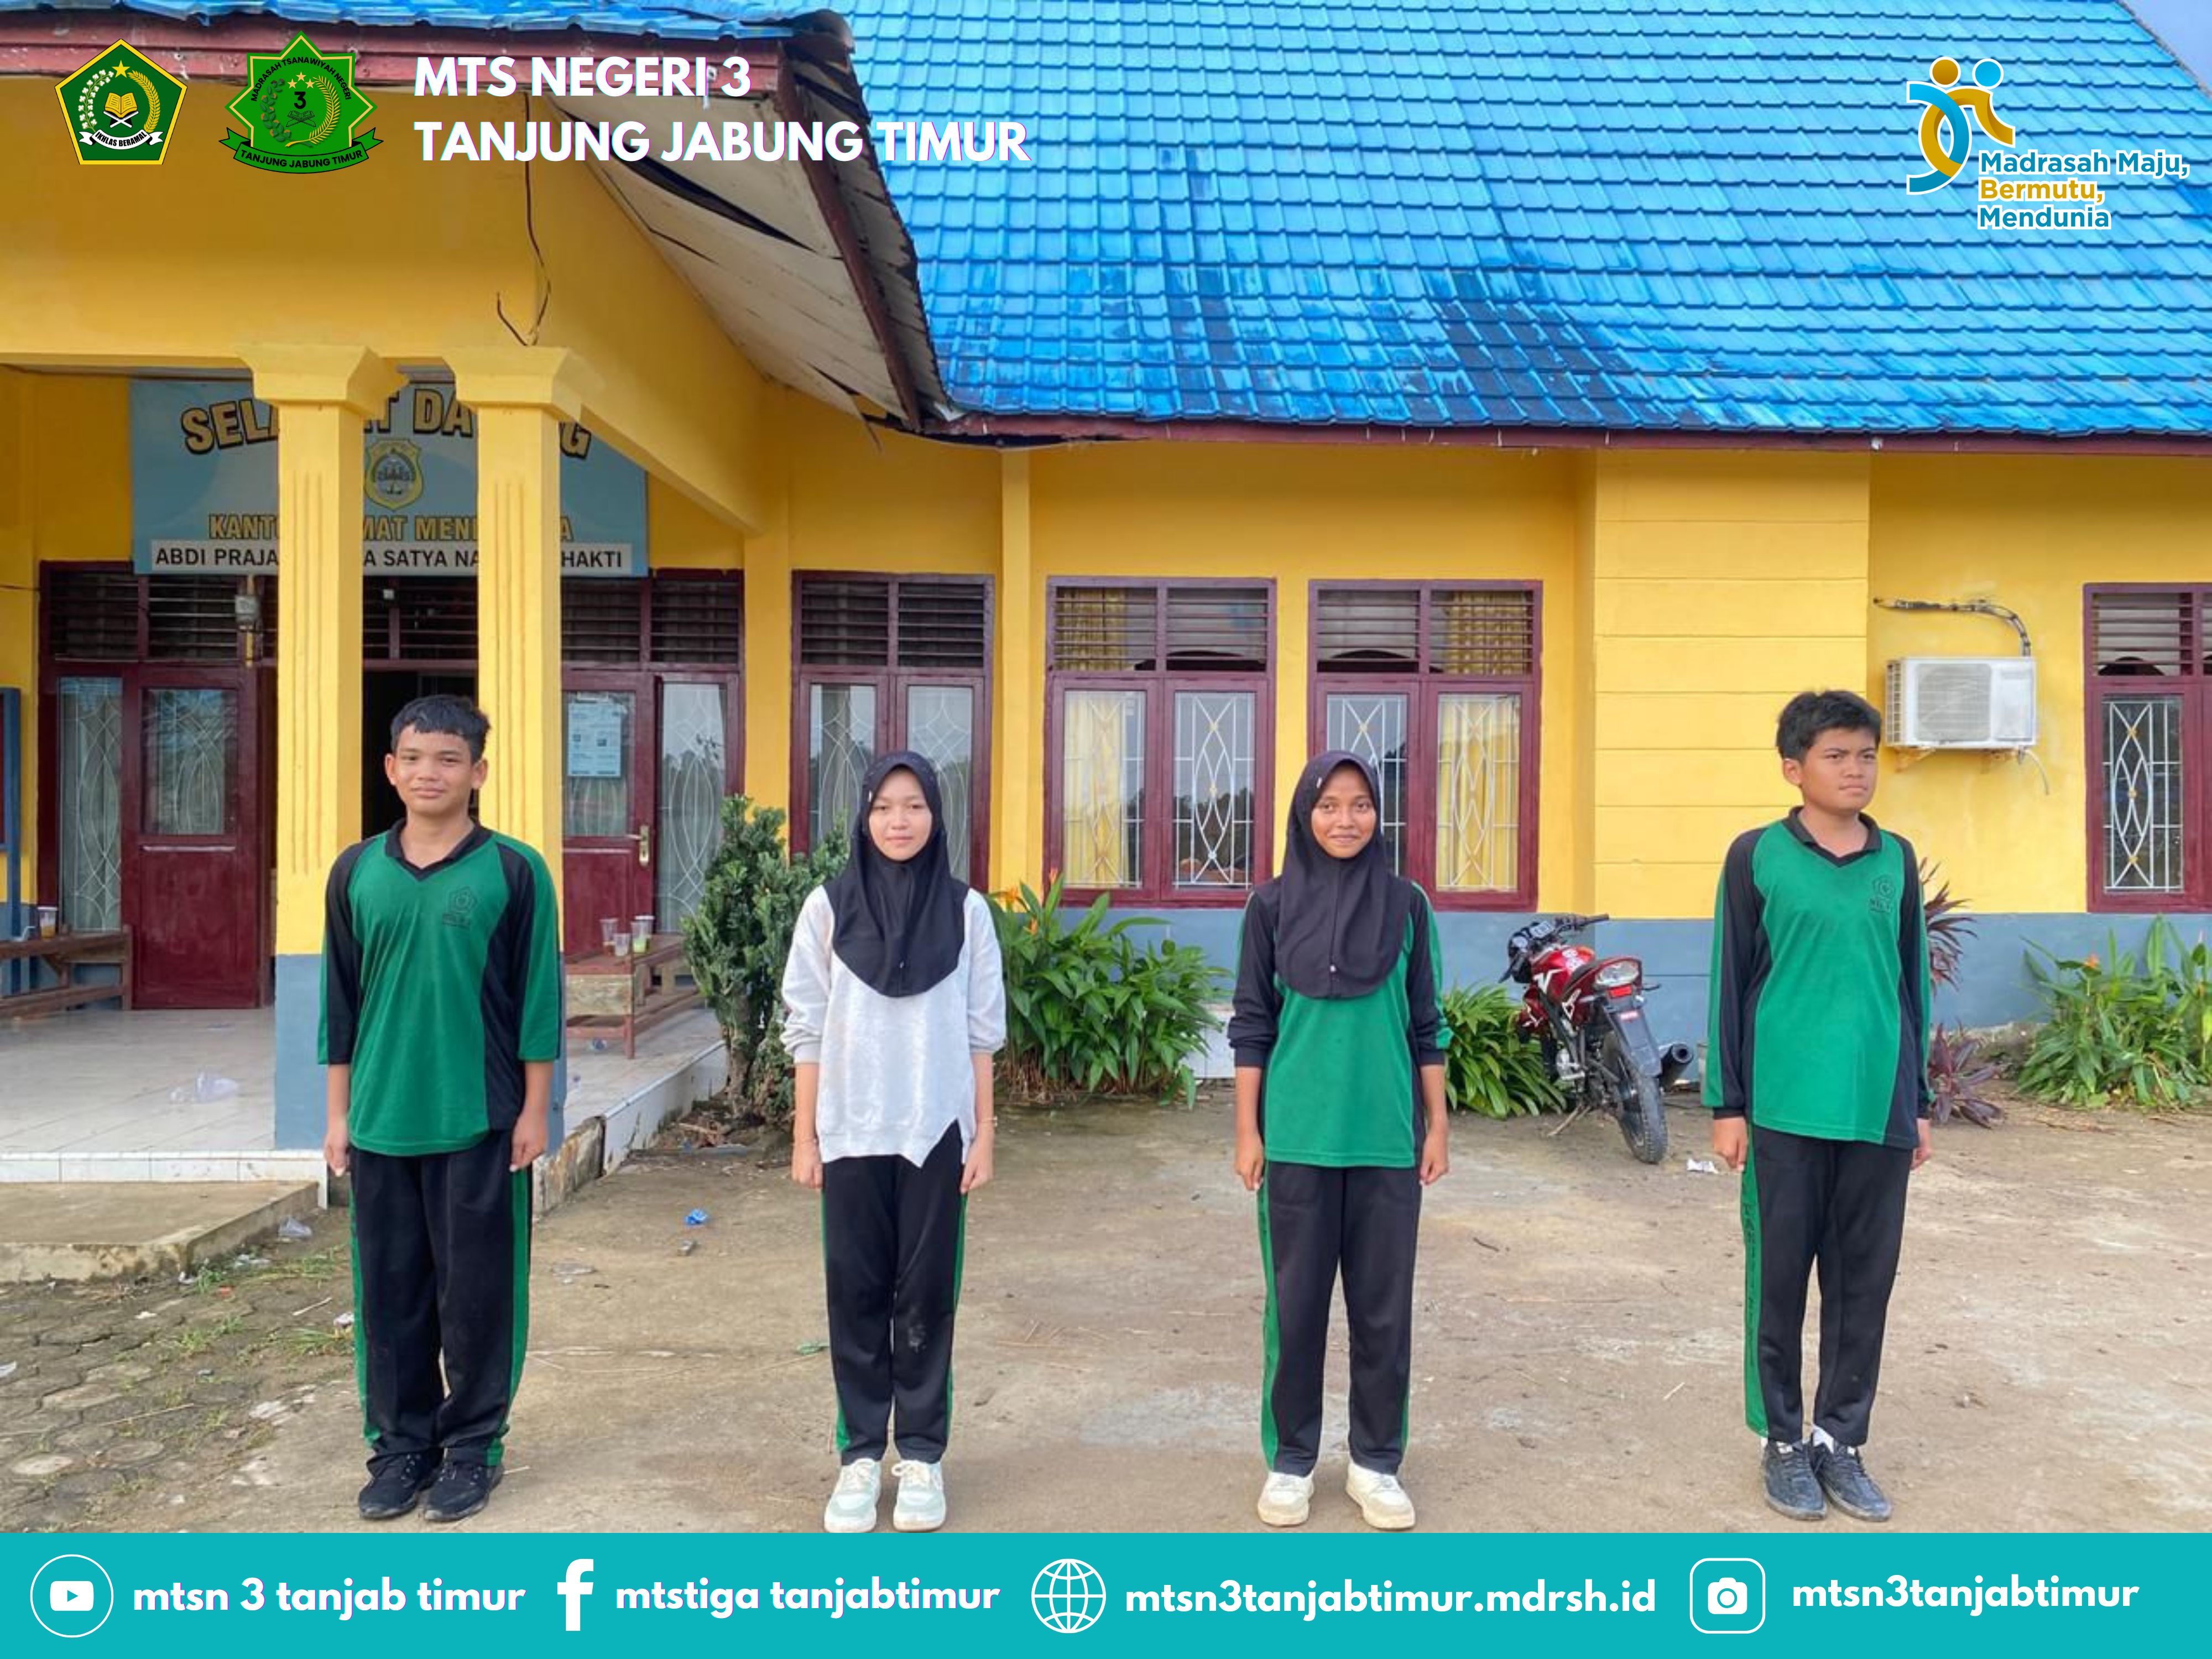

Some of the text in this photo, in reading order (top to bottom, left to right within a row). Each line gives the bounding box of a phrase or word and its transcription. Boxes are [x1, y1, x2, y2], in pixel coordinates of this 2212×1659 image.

[155, 547, 205, 565] ABDI
[215, 547, 279, 566] PRAJA
[383, 549, 447, 567] SATYA
[561, 551, 622, 567] HAKTI
